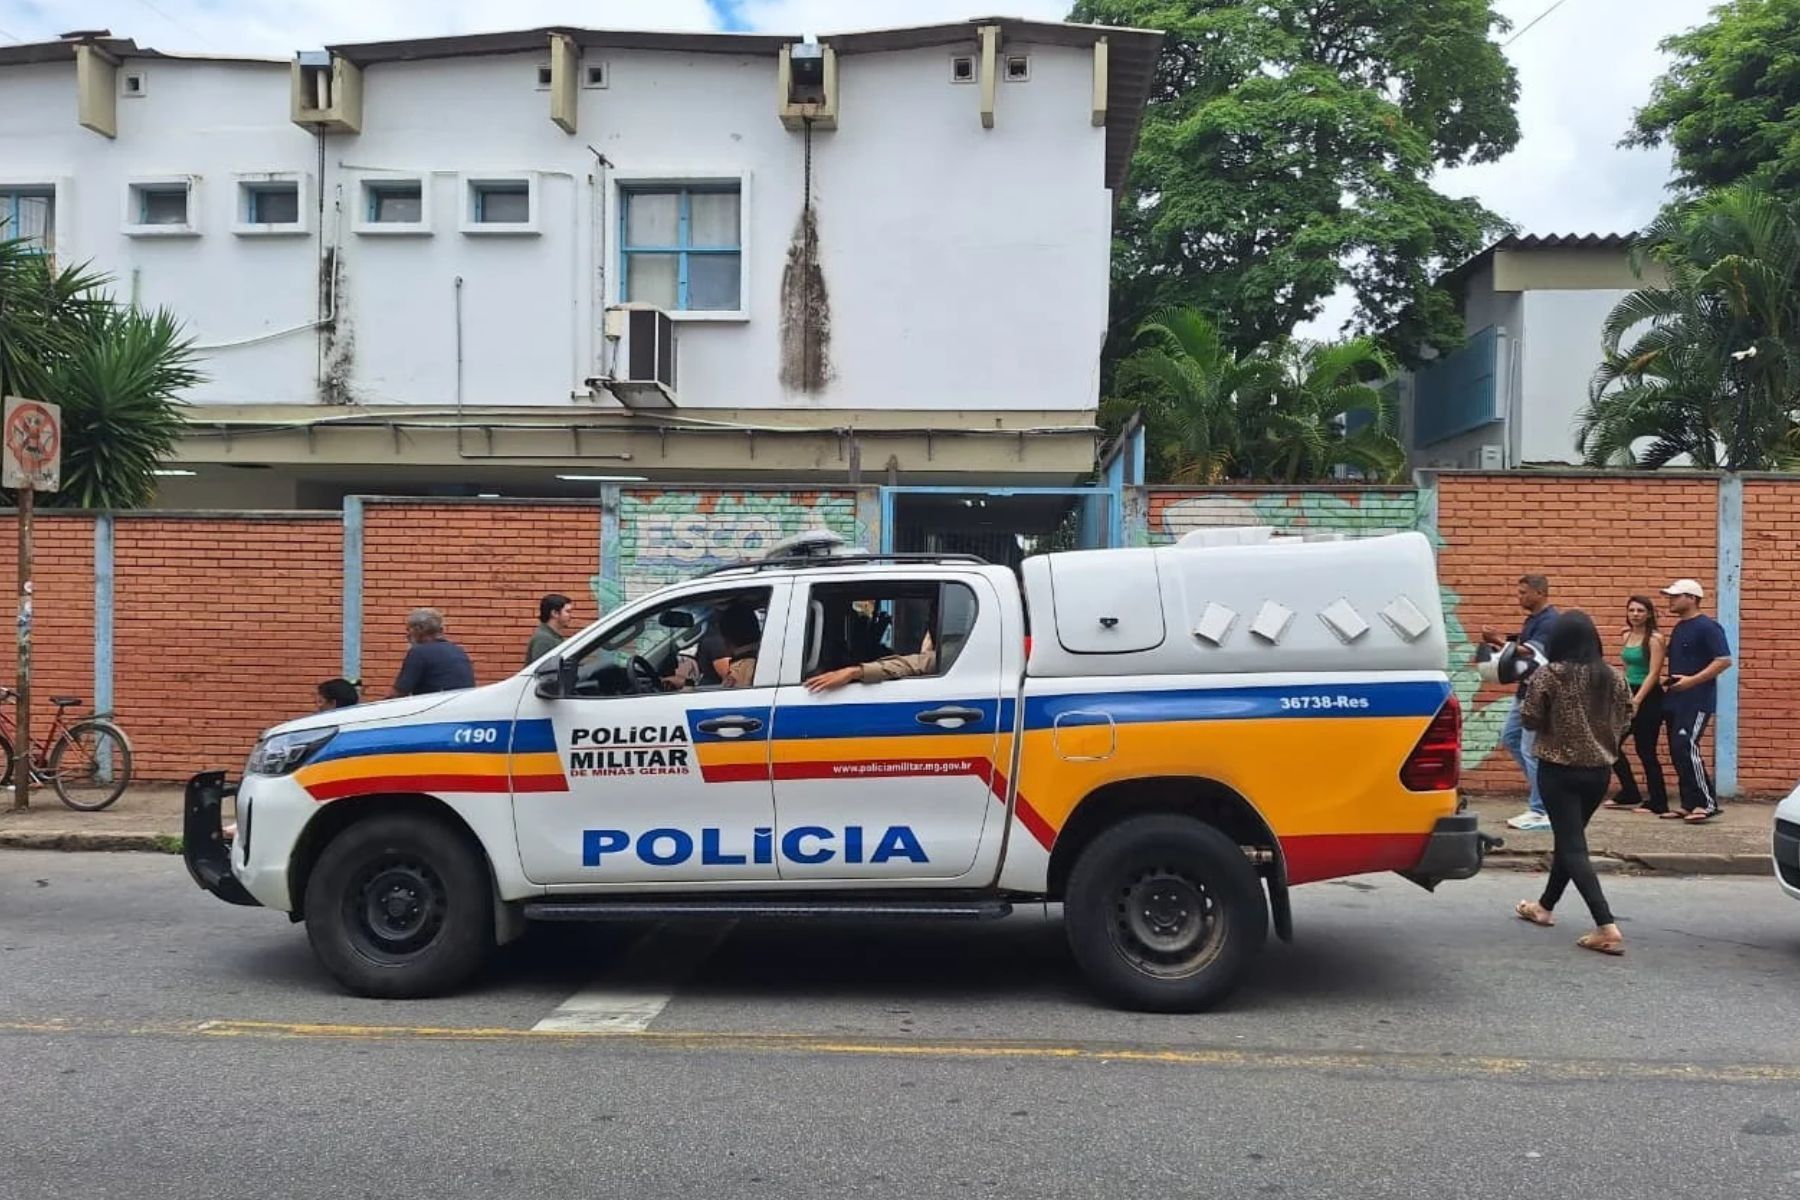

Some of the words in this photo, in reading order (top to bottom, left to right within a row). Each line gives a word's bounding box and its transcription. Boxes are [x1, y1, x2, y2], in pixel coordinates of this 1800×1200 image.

[1280, 695, 1370, 710] 36738-Res
[570, 749, 688, 769] MILITAR
[570, 768, 588, 777] DE
[591, 767, 635, 777] MINAS
[639, 766, 690, 776] GERAIS
[832, 761, 973, 774] www.policiamilitar.mg.gov.br
